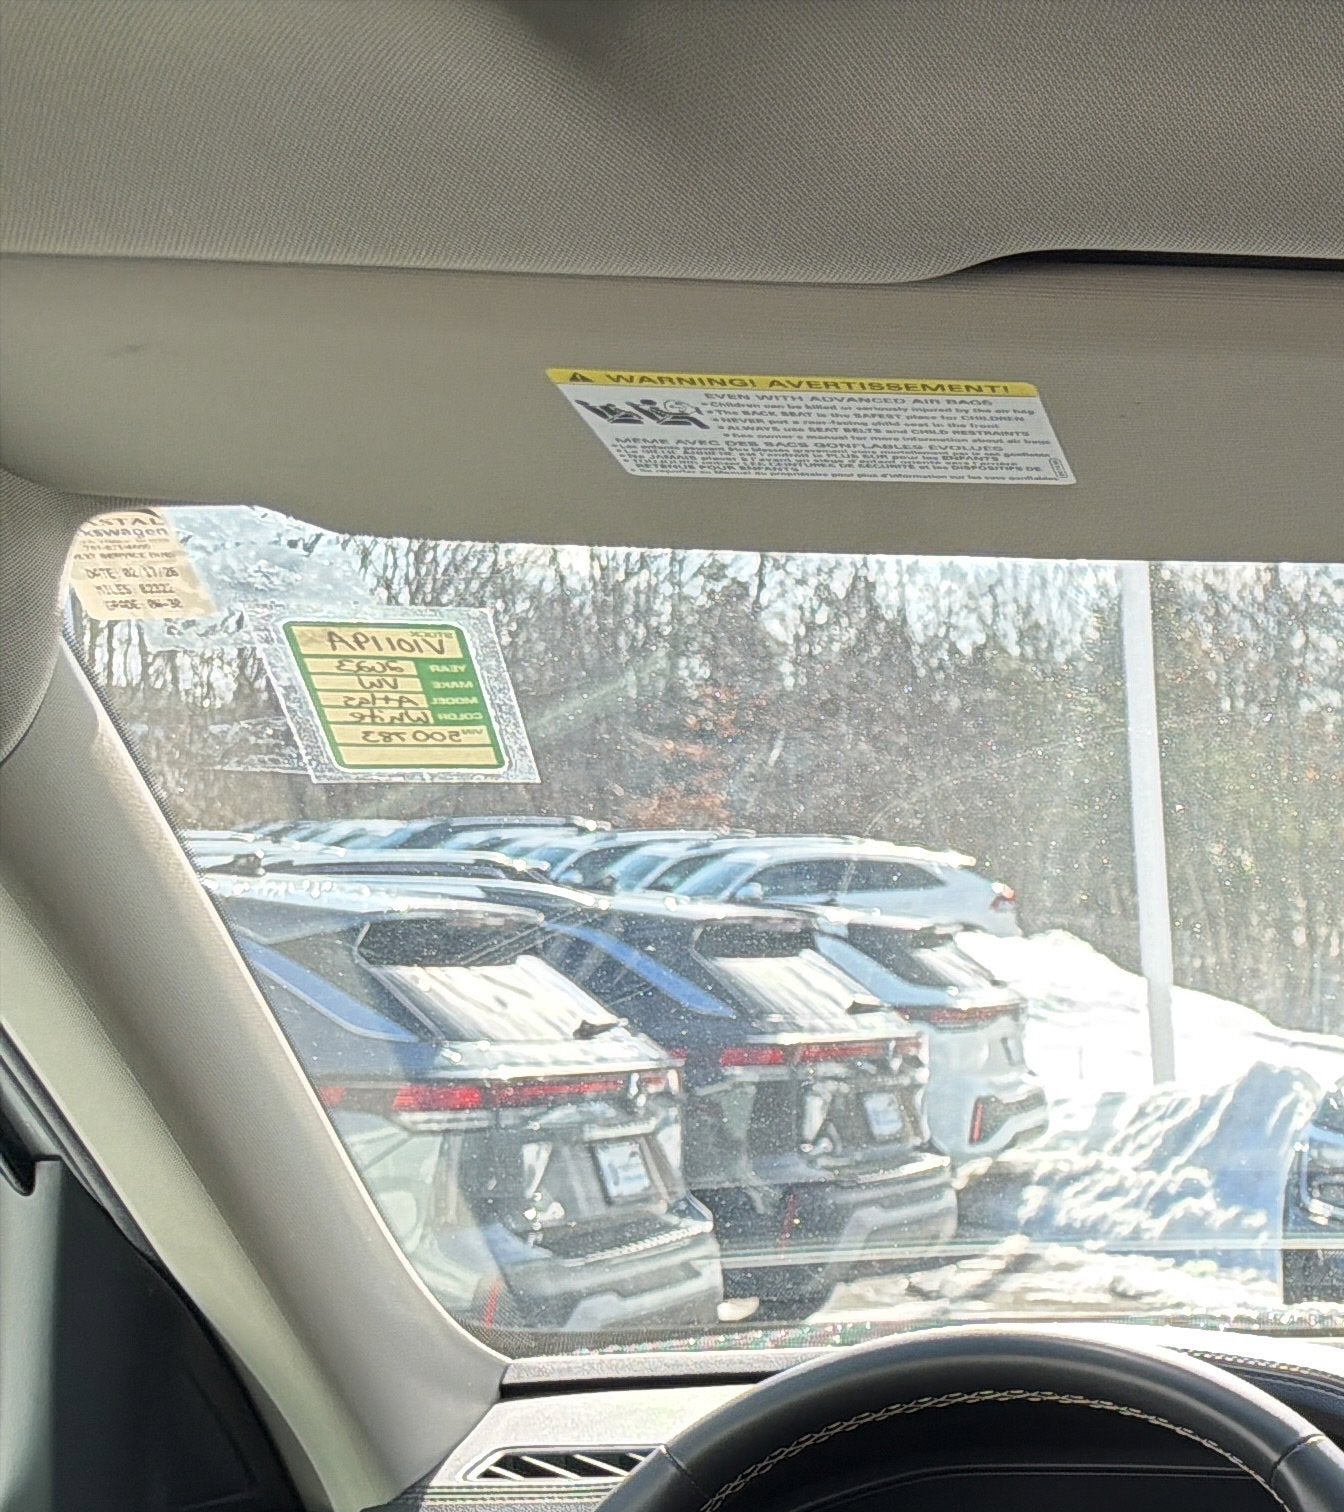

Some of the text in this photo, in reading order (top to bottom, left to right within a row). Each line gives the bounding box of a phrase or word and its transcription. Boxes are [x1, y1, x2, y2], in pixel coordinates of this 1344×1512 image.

[605, 374, 1009, 394] WARNING! AVERTISSEMENT!
[809, 396, 905, 404] ADVANCED
